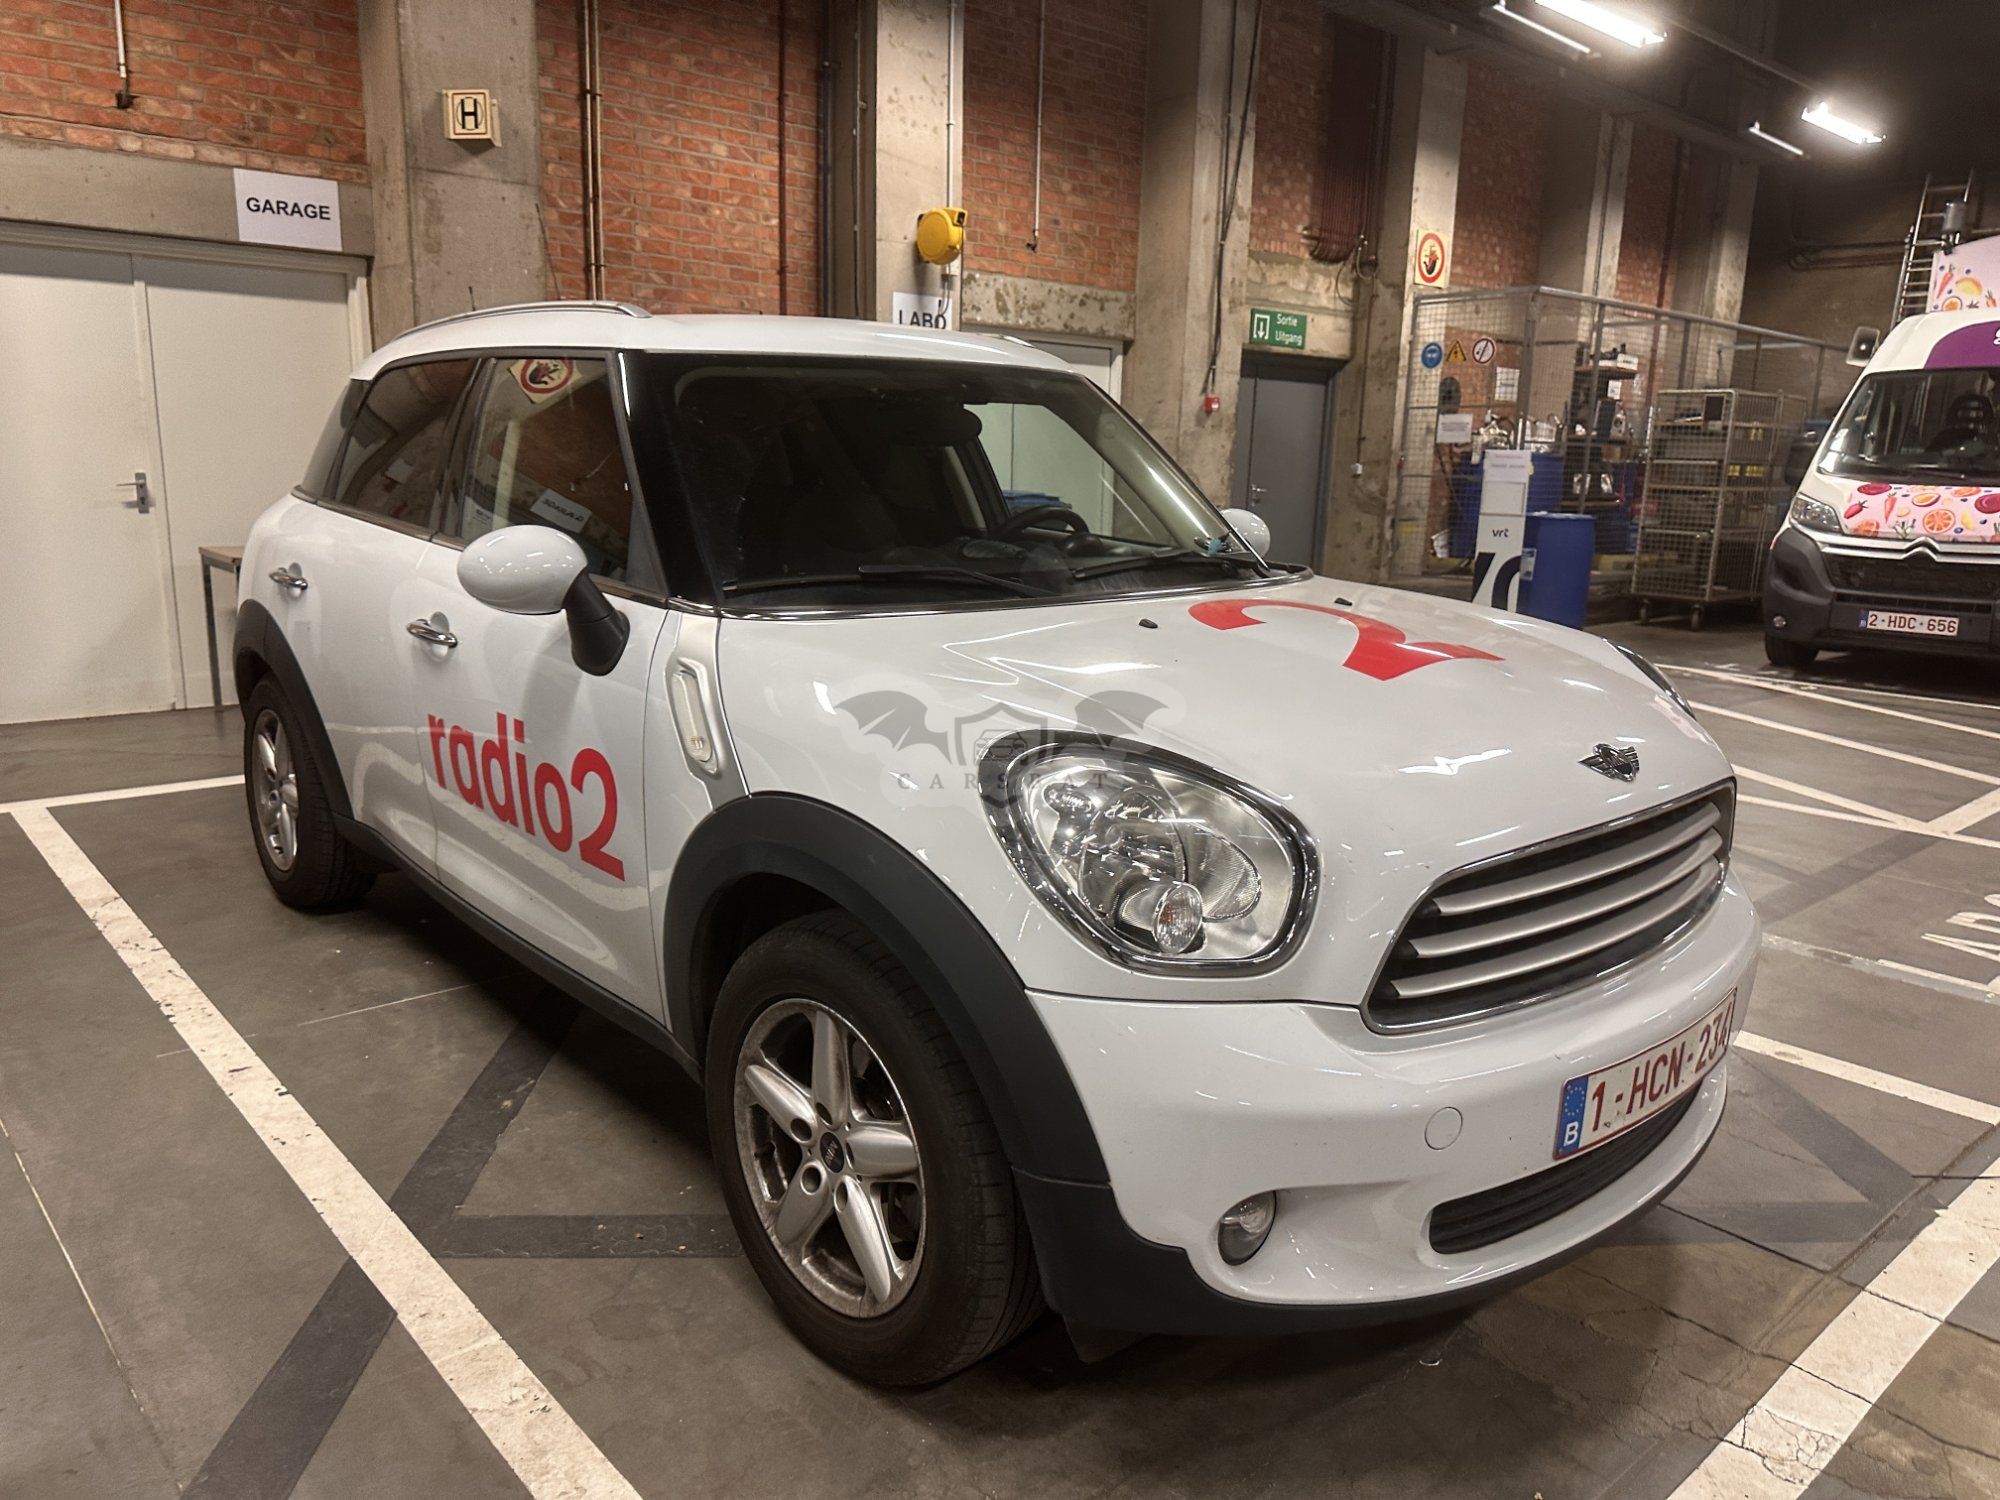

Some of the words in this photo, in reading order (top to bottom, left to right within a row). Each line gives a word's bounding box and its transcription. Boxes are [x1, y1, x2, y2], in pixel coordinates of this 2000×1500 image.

[461, 98, 478, 129] H
[246, 197, 331, 220] GARAGE
[1492, 528, 1509, 538] vrt
[428, 712, 625, 882] radio2
[1563, 1121, 1579, 1147] B
